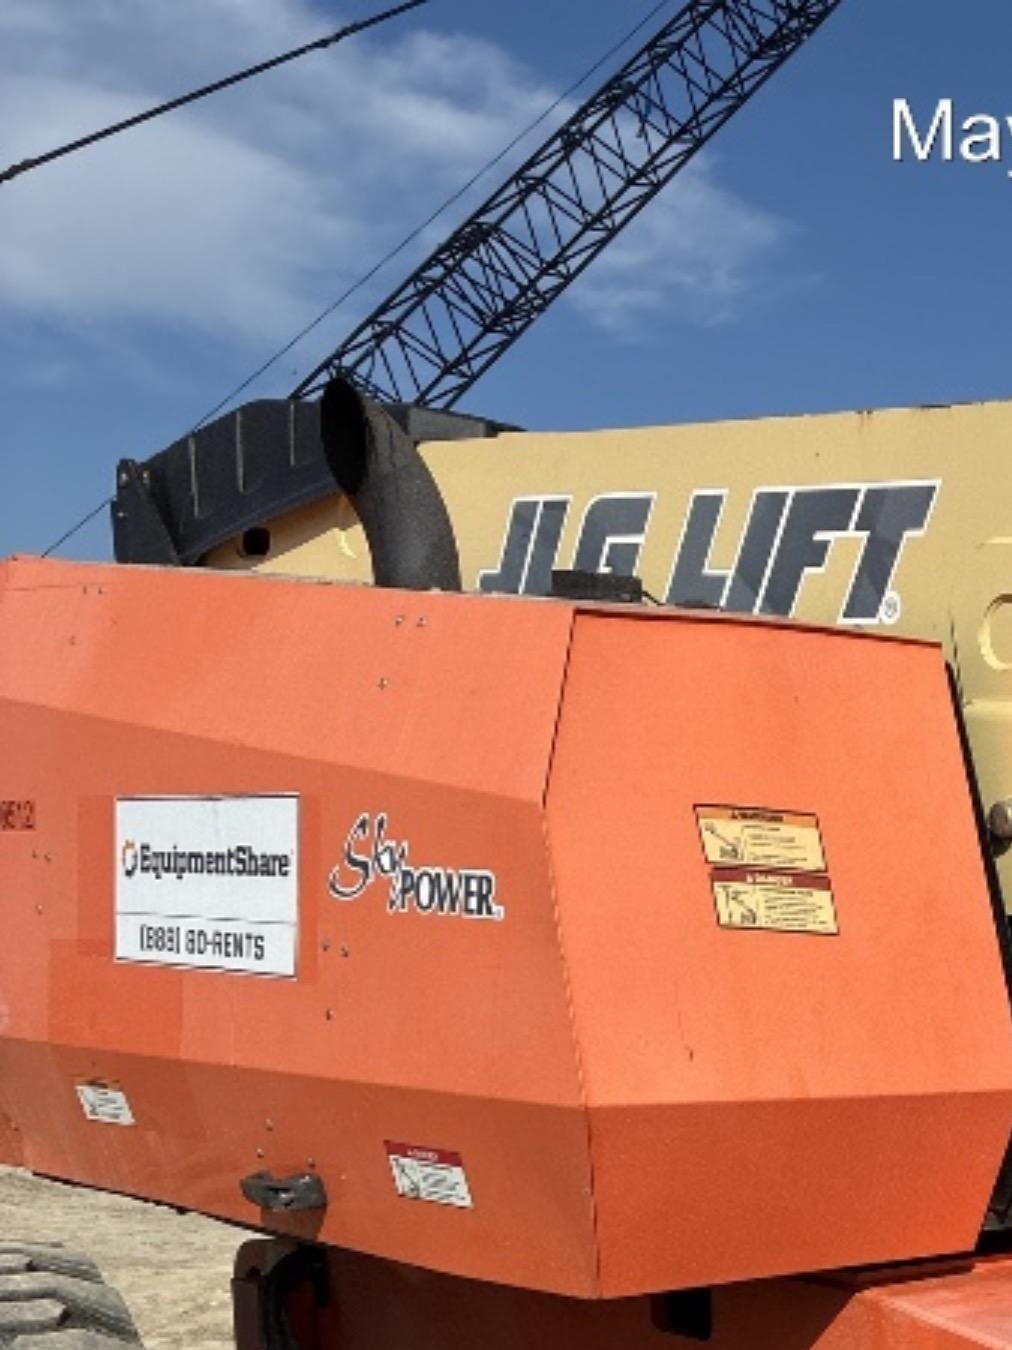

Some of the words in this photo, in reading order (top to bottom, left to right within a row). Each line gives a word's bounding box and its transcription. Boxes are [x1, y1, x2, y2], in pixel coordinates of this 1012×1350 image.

[662, 478, 943, 625] LIFT
[139, 843, 290, 880] EquipmentShare
[399, 868, 495, 917] POWER
